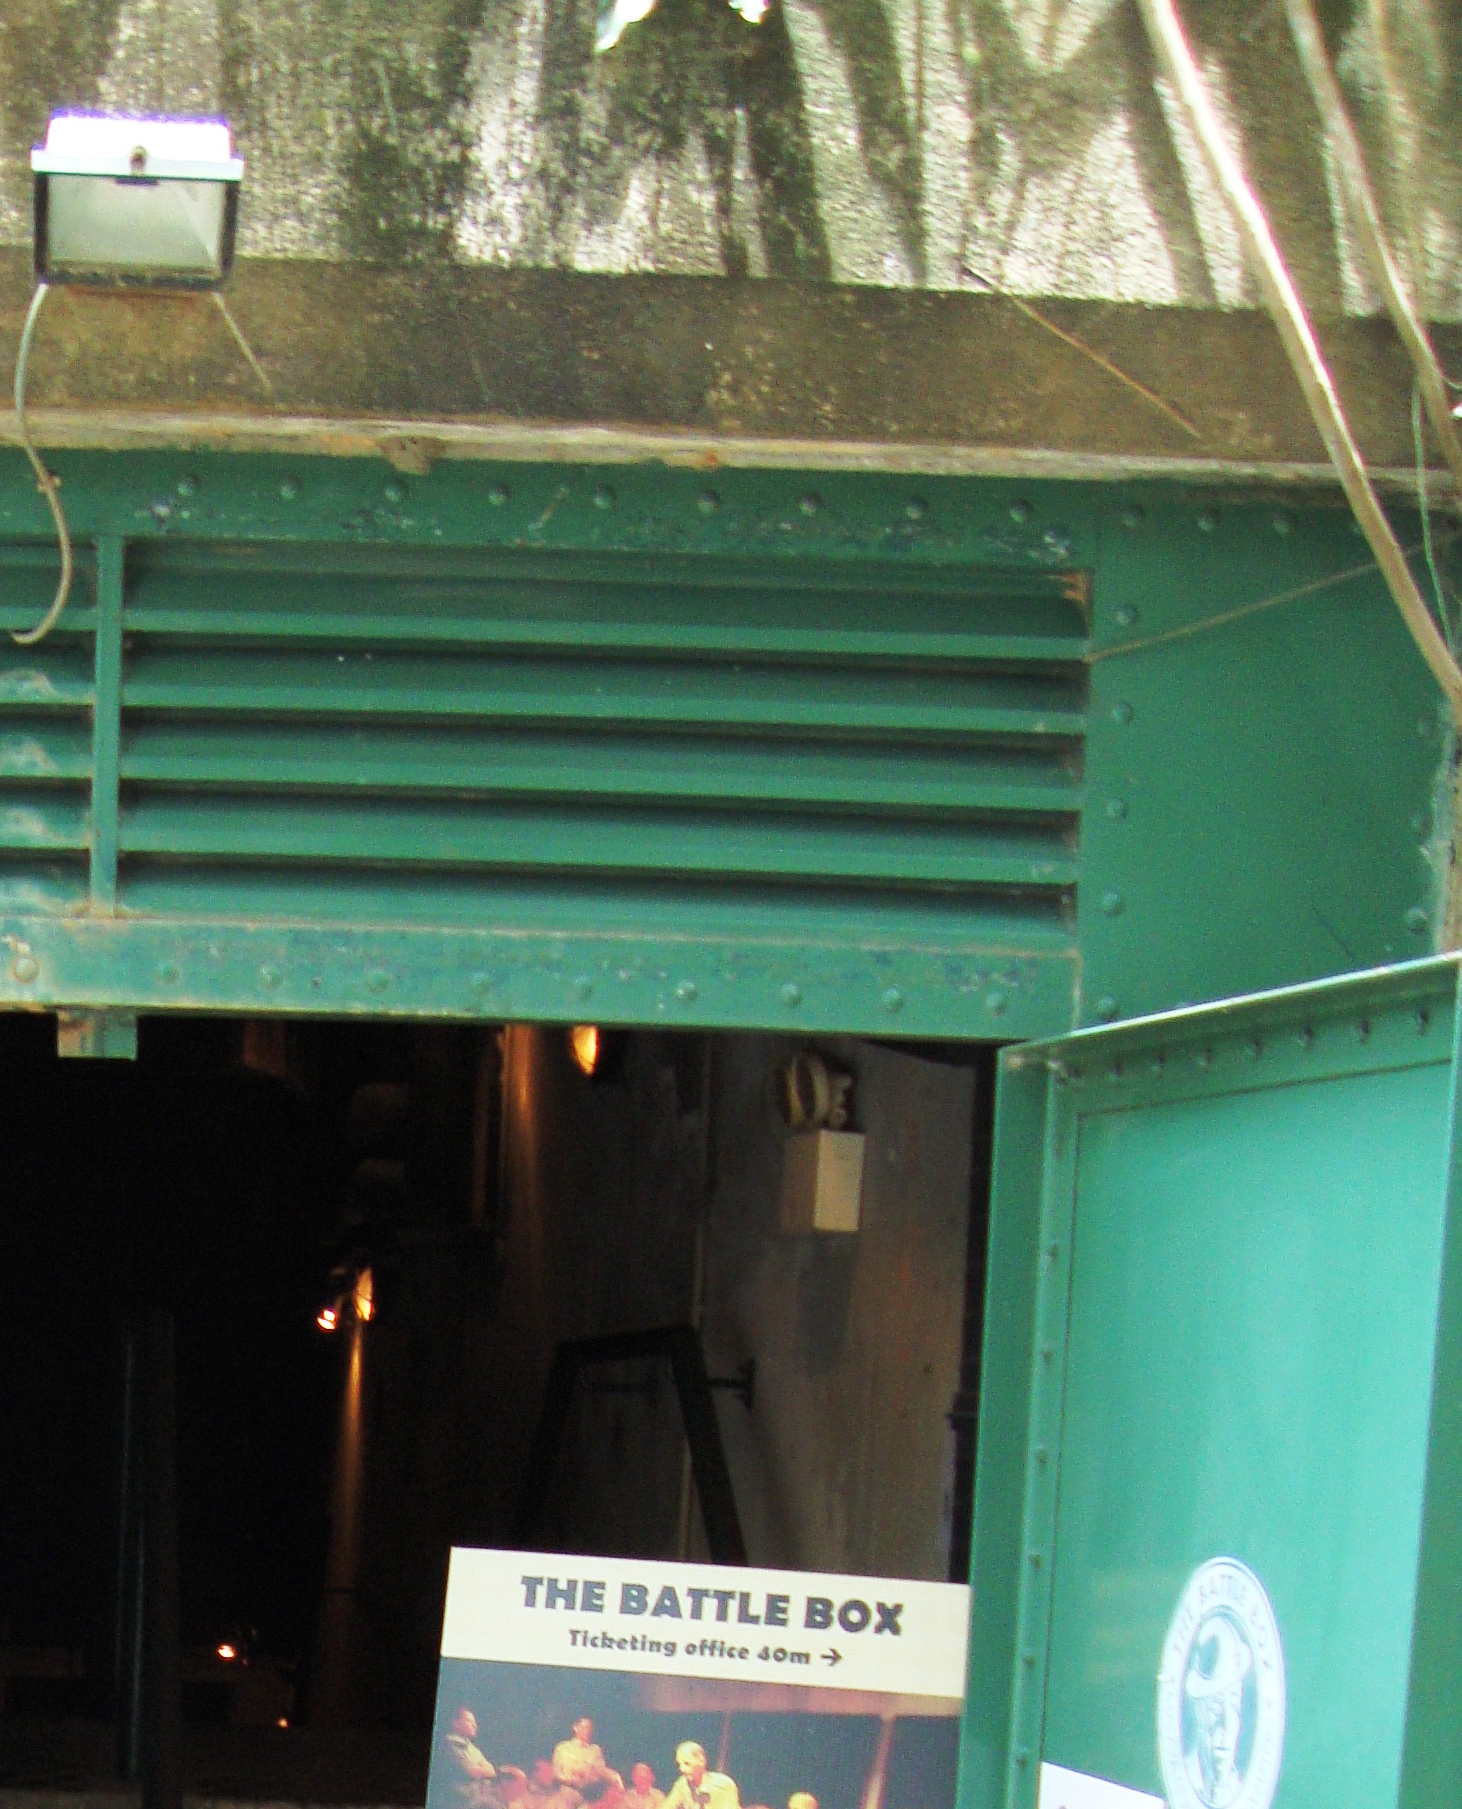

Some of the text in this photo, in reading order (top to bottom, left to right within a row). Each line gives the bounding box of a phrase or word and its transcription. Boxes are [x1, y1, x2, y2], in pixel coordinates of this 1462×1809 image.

[521, 1575, 905, 1636] THE BATTLE BOX
[1198, 1573, 1247, 1608] BATTLE
[569, 1630, 810, 1665] Ticketing office 40m
